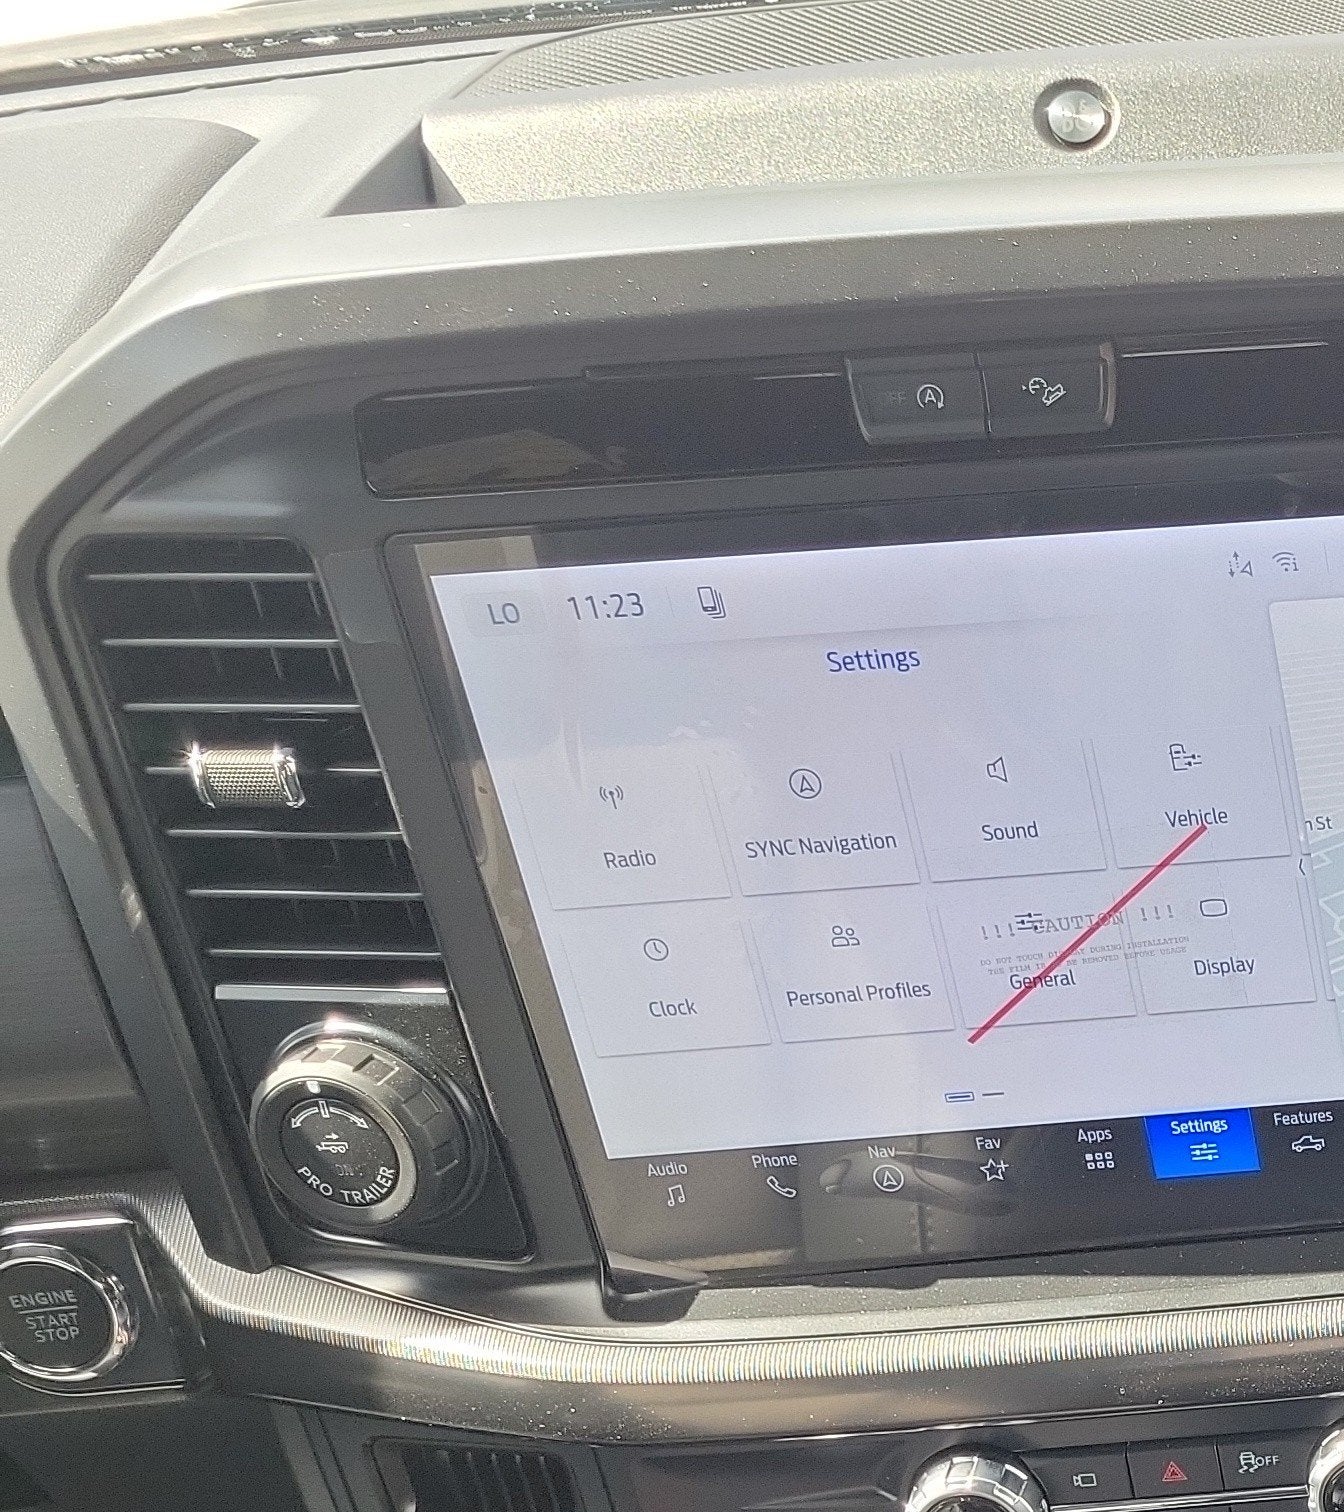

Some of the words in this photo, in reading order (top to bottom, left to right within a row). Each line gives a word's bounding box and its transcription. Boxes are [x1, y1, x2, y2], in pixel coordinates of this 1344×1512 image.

[488, 602, 521, 626] LO
[567, 592, 646, 622] 11:23
[826, 647, 921, 674] Settings
[1164, 807, 1229, 829] Vehicle
[1316, 816, 1333, 831] St
[981, 820, 1039, 842] Sound
[744, 838, 796, 859] SYNC
[798, 832, 898, 856] Navigation
[603, 849, 657, 869] Radio
[1127, 936, 1190, 949] INSTALLATION
[1193, 956, 1256, 976] Display
[1009, 968, 1077, 990] General
[786, 986, 863, 1008] Personal
[865, 980, 932, 1002] Profiles
[649, 998, 698, 1018] Clock
[1170, 1117, 1229, 1135] Settings
[1273, 1109, 1334, 1127] Features
[975, 1135, 1002, 1152] Fav
[1077, 1127, 1113, 1144] Apps
[751, 1152, 799, 1170] Phone
[868, 1144, 897, 1160] Nav
[647, 1161, 689, 1178] Audio
[297, 1166, 333, 1196] PRO
[340, 1166, 396, 1204] TRAILER
[8, 1289, 79, 1309] ENGINE
[25, 1312, 79, 1330] START
[34, 1326, 80, 1344] STOP
[1255, 1455, 1280, 1468] OFF
